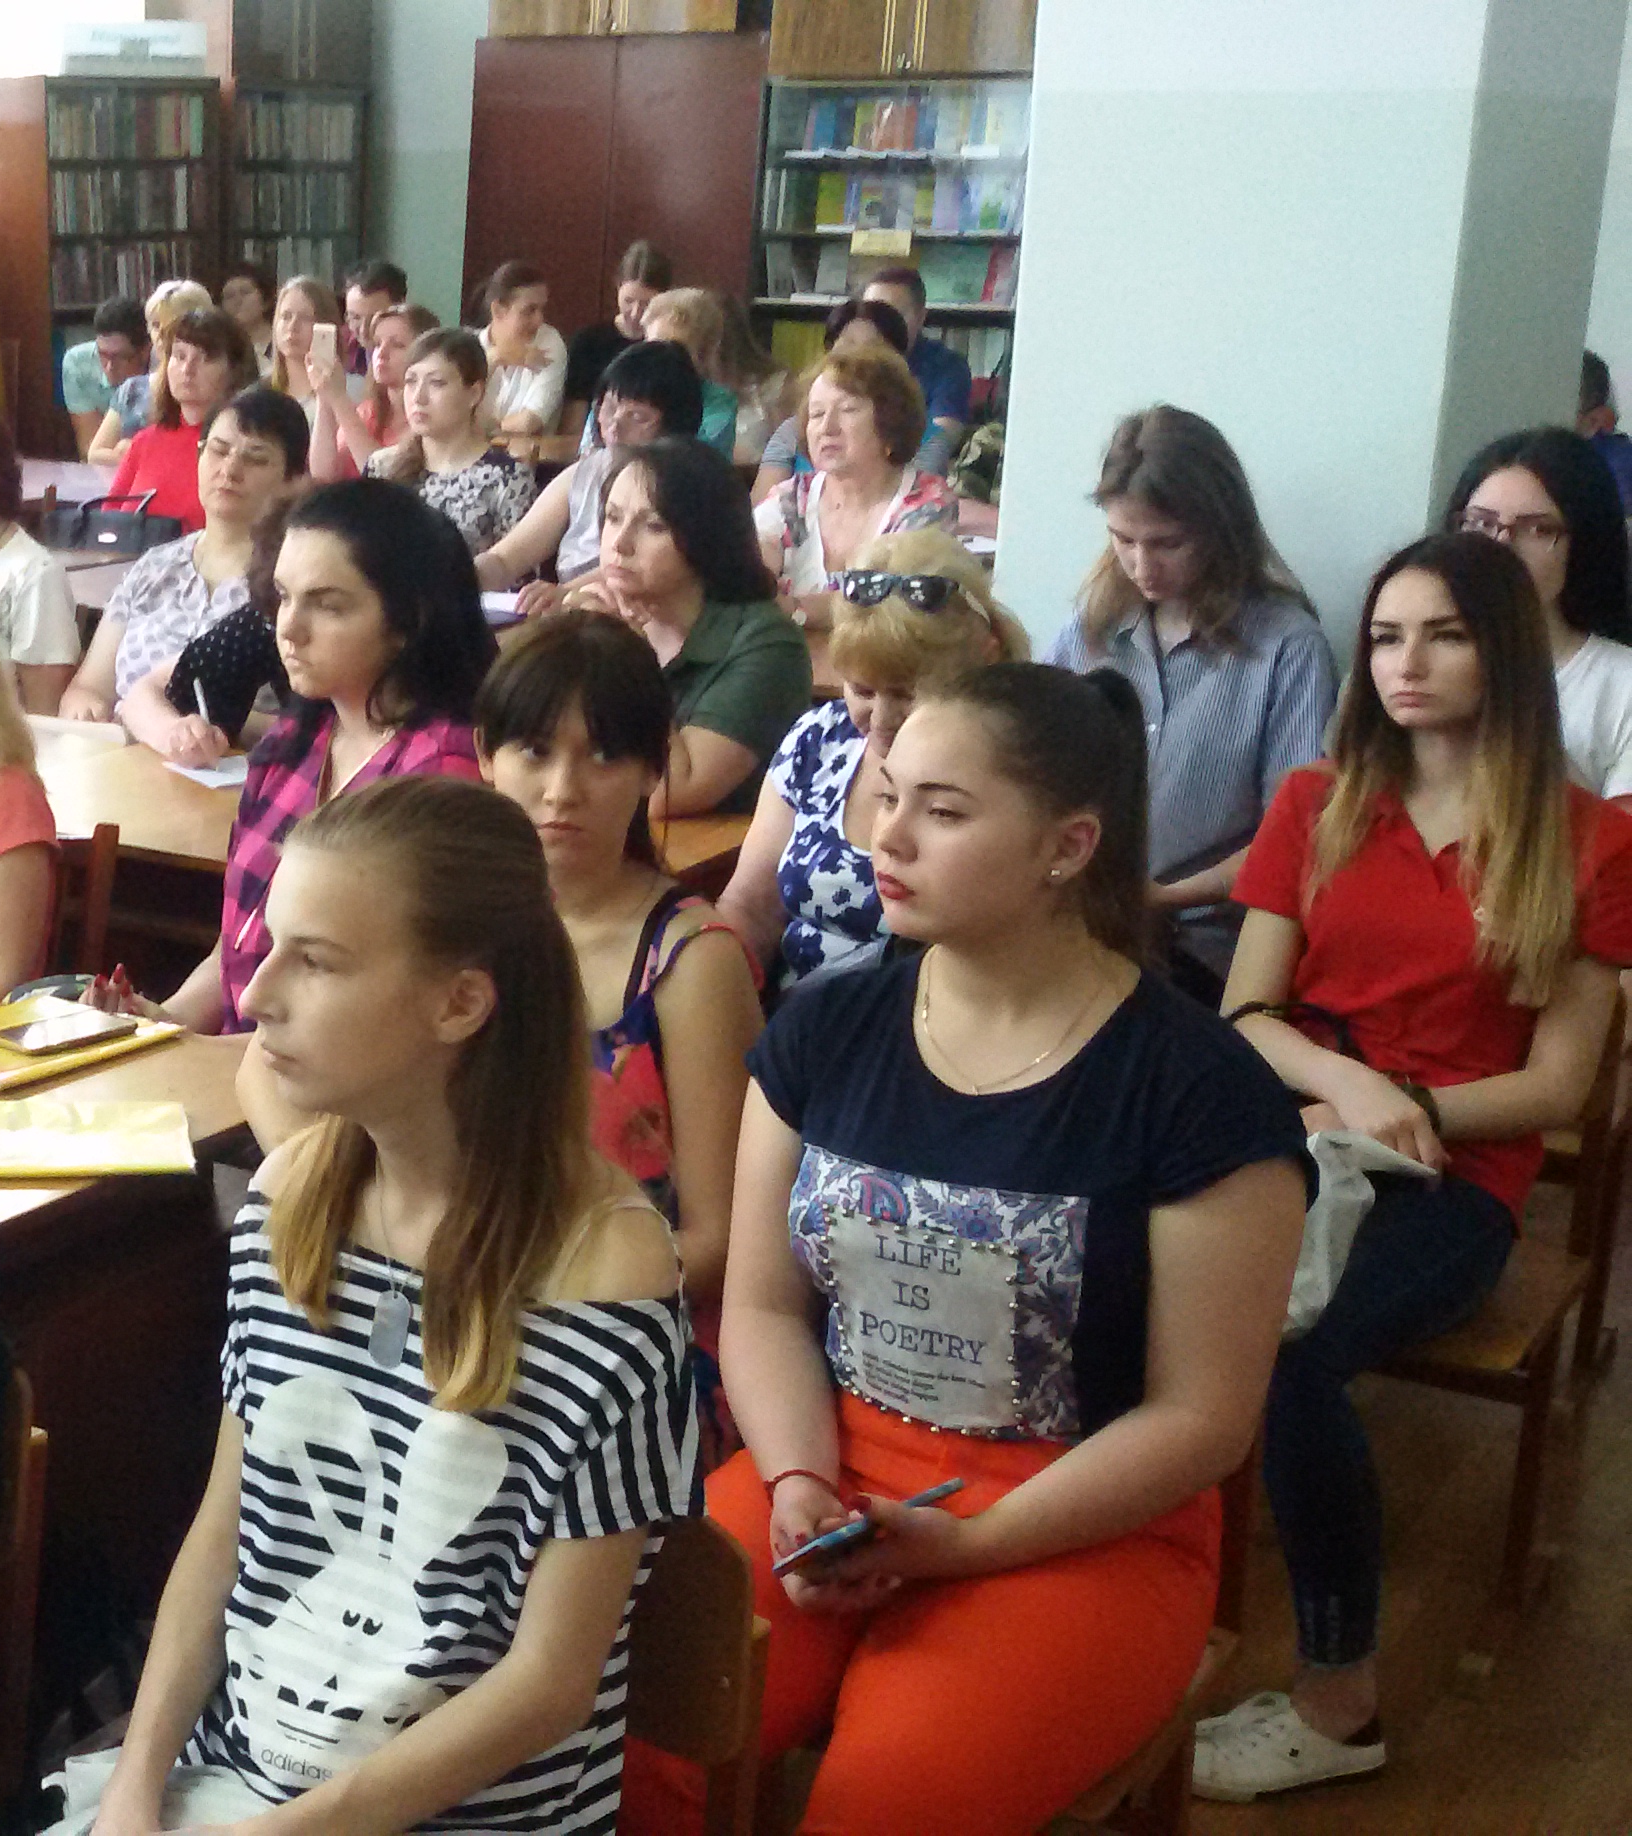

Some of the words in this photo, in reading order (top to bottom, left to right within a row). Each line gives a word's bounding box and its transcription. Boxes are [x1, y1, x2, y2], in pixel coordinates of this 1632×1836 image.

[875, 1234, 962, 1276] LIFE
[891, 1279, 931, 1311] IS
[859, 1310, 988, 1365] POETRY
